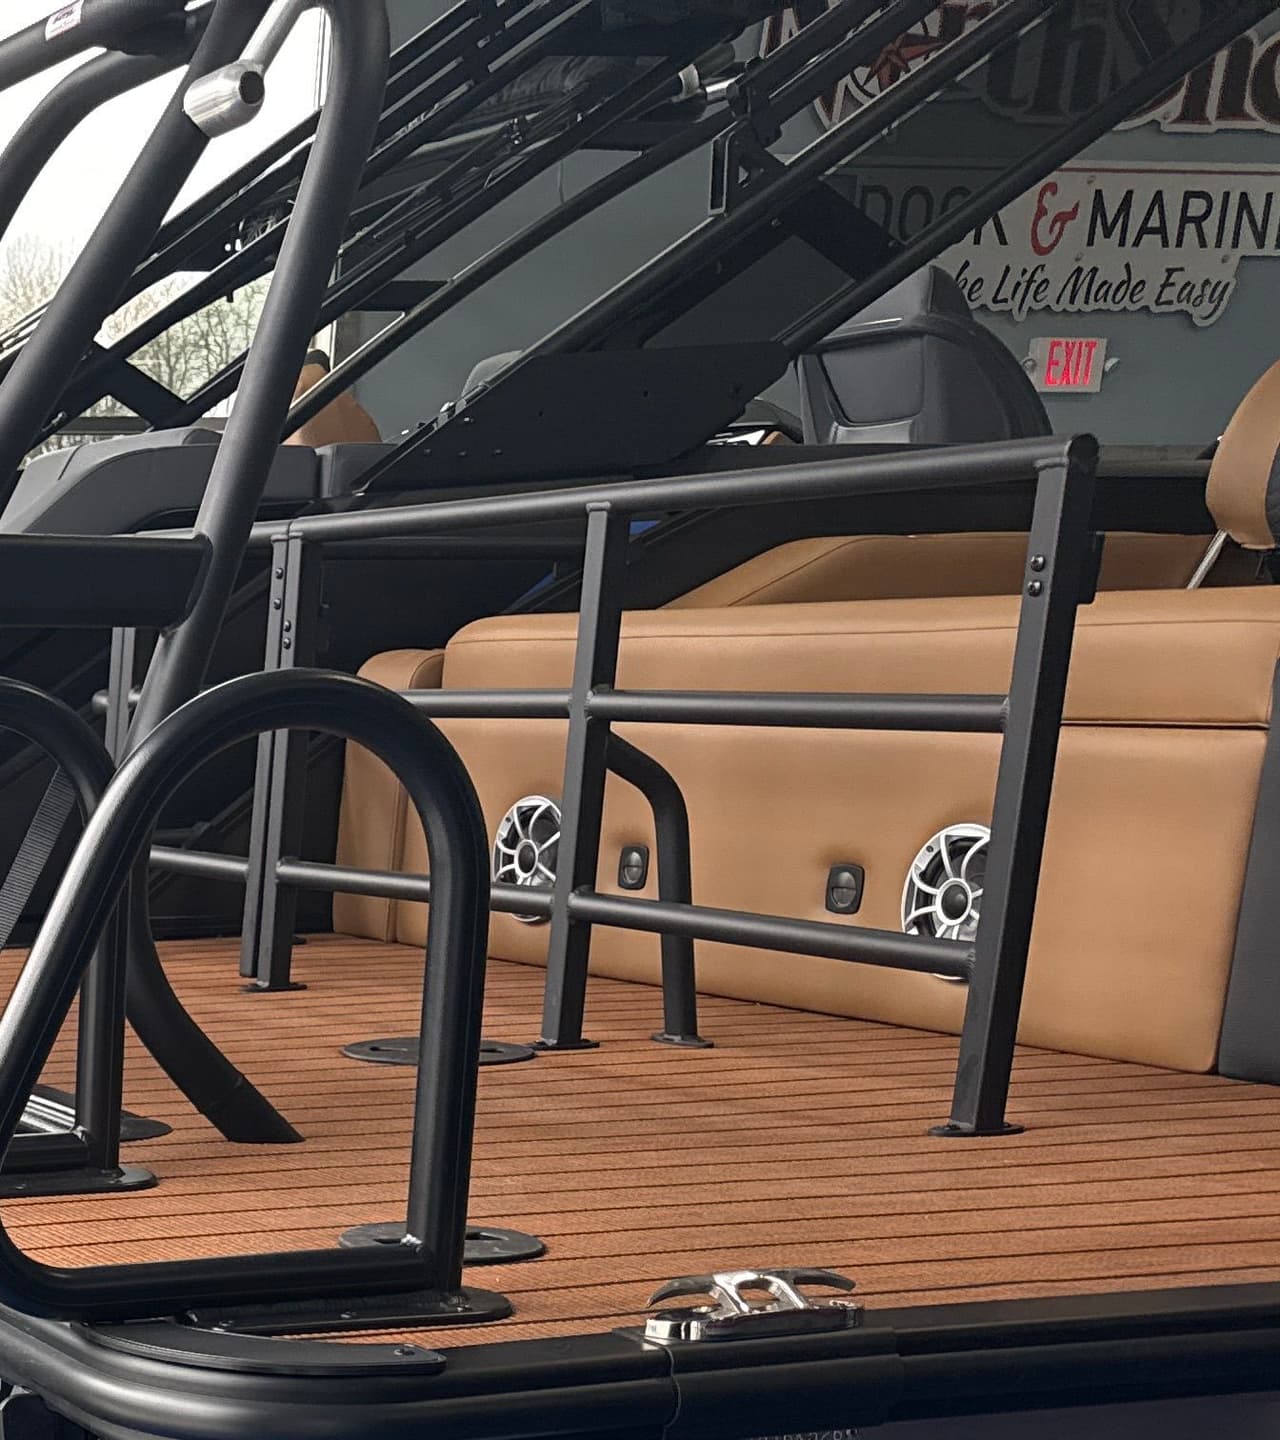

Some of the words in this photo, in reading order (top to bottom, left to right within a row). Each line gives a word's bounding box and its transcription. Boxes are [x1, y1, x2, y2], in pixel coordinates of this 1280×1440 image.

[1030, 181, 1080, 257] &
[1086, 188, 1280, 250] MARIN
[991, 264, 1050, 315] Life
[1055, 262, 1147, 306] Made
[1154, 266, 1232, 320] Easy
[1044, 340, 1098, 386] EXIT
